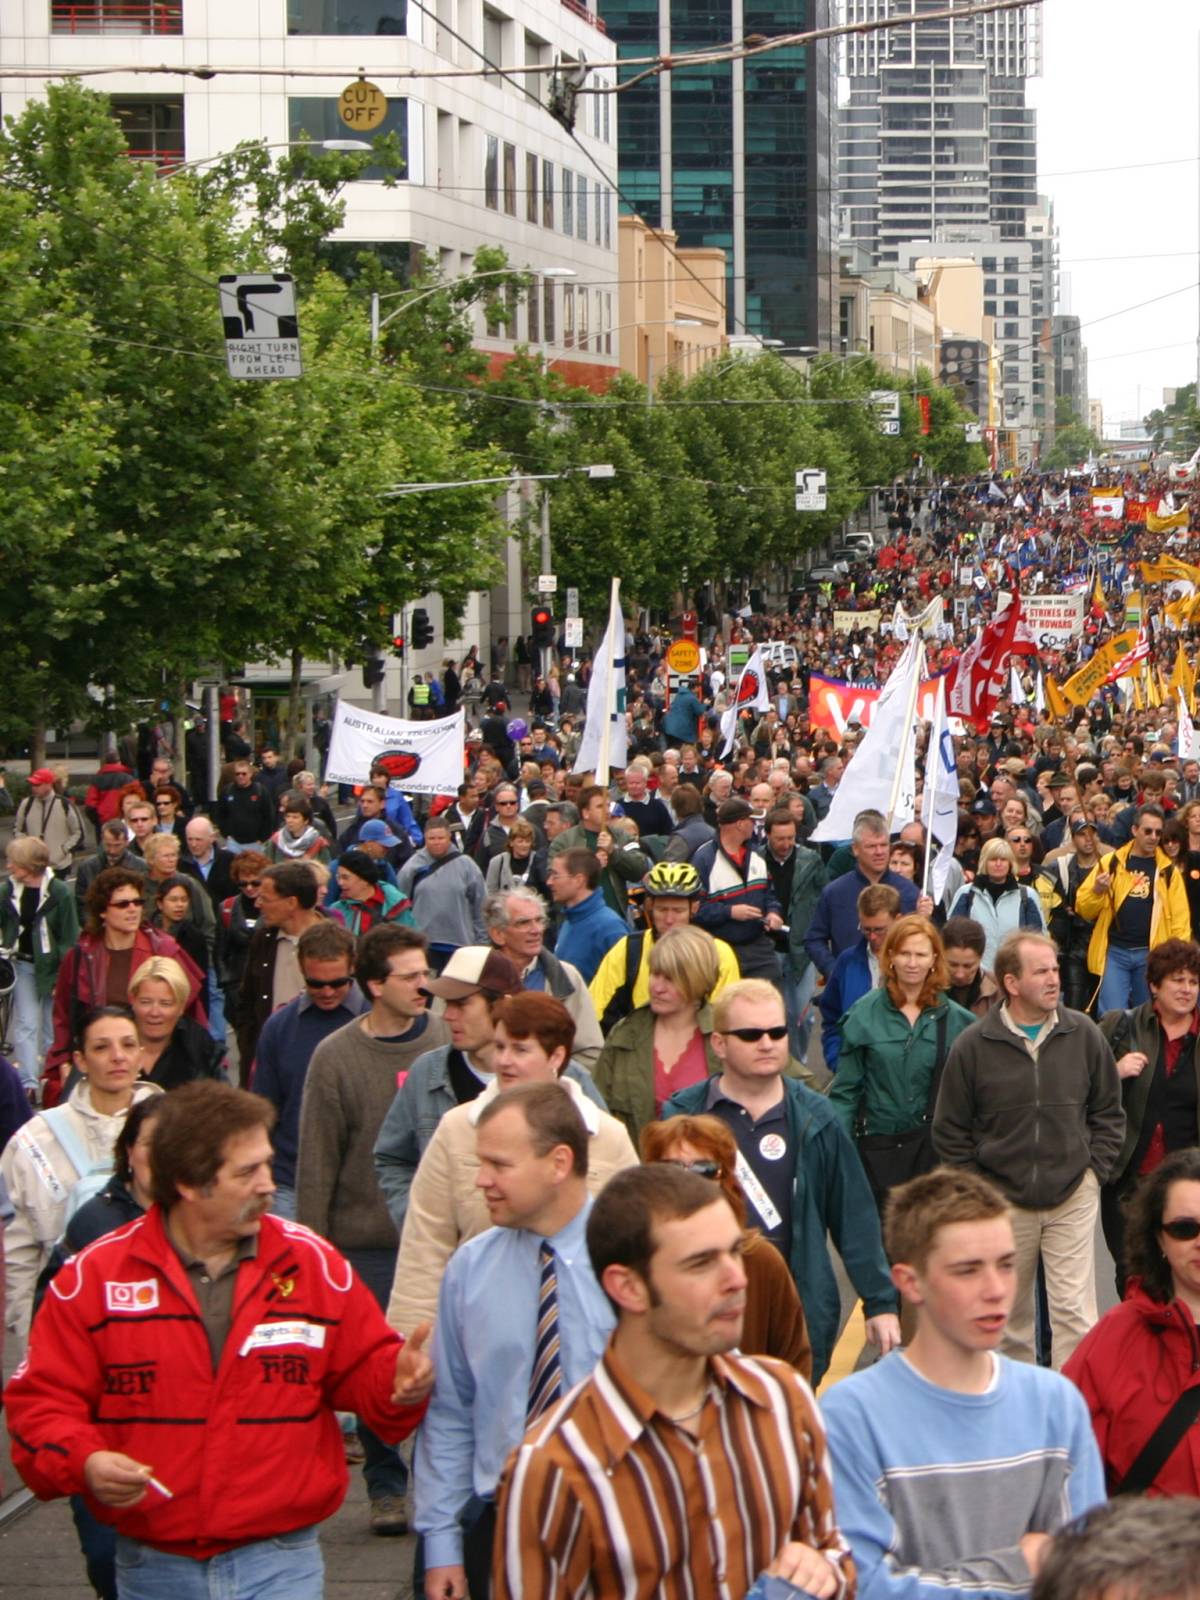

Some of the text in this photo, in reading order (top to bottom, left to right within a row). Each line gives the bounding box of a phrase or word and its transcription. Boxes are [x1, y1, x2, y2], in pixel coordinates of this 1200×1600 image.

[343, 89, 380, 104] CUT
[343, 107, 379, 122] OFF
[228, 343, 297, 353] RIGHT TURN
[232, 354, 296, 364] FROM LEFT
[246, 365, 285, 375] AHEAD
[1029, 609, 1077, 617] STRIKES CAN
[1040, 620, 1073, 629] HOWARD
[845, 682, 877, 690] UNITED
[383, 738, 413, 746] UNION
[391, 781, 435, 793] Secondary
[435, 784, 458, 793] Colle
